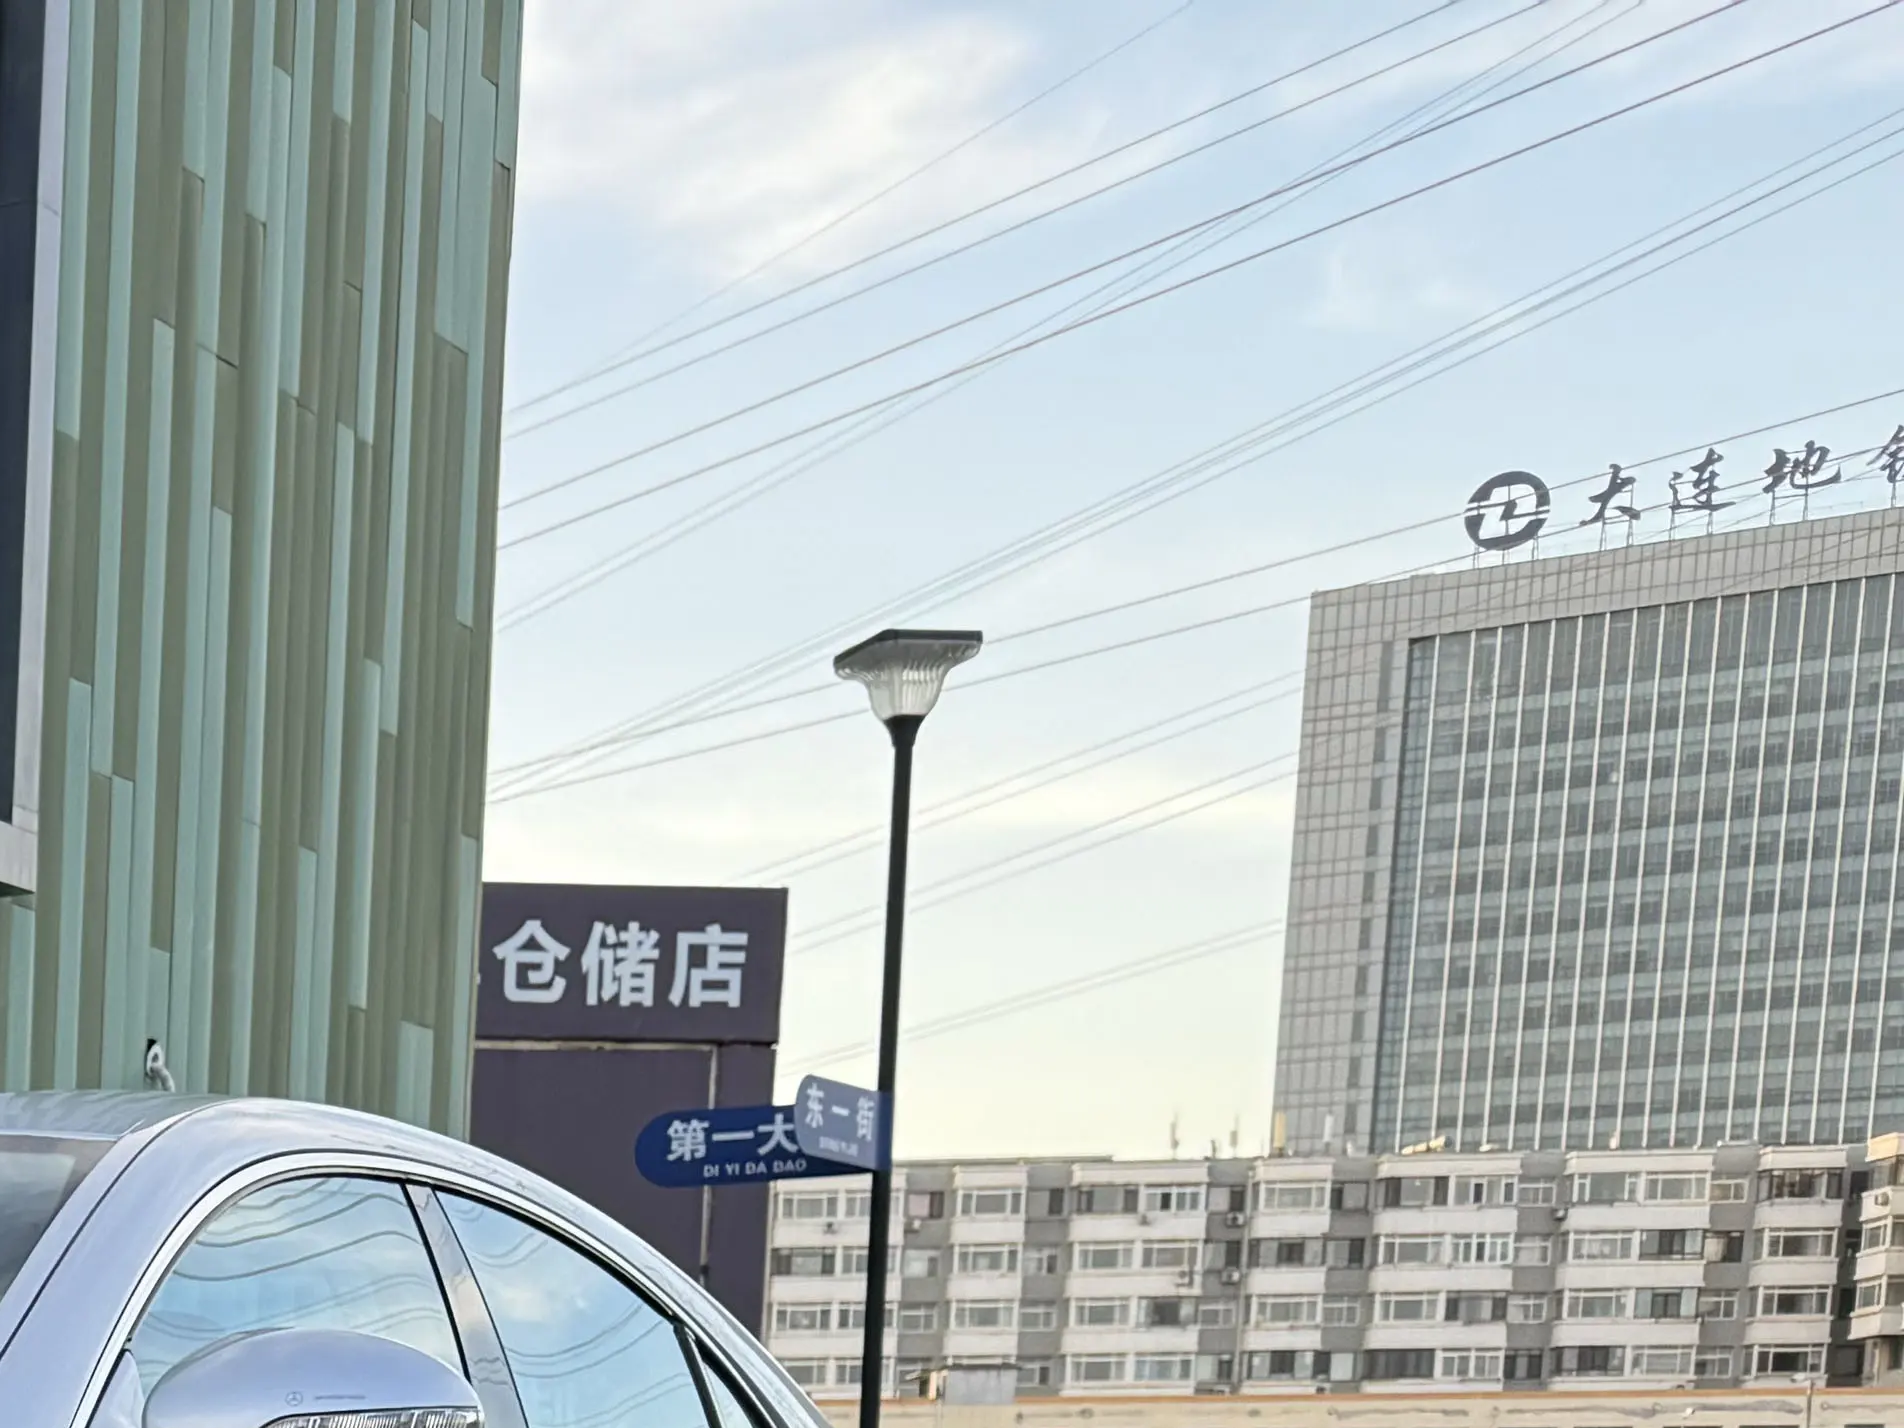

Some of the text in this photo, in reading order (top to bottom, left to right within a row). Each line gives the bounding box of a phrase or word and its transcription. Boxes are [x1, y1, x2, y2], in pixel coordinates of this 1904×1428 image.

[805, 1082, 876, 1142] 东一街
[703, 1158, 807, 1177] DI YI DA DAO
